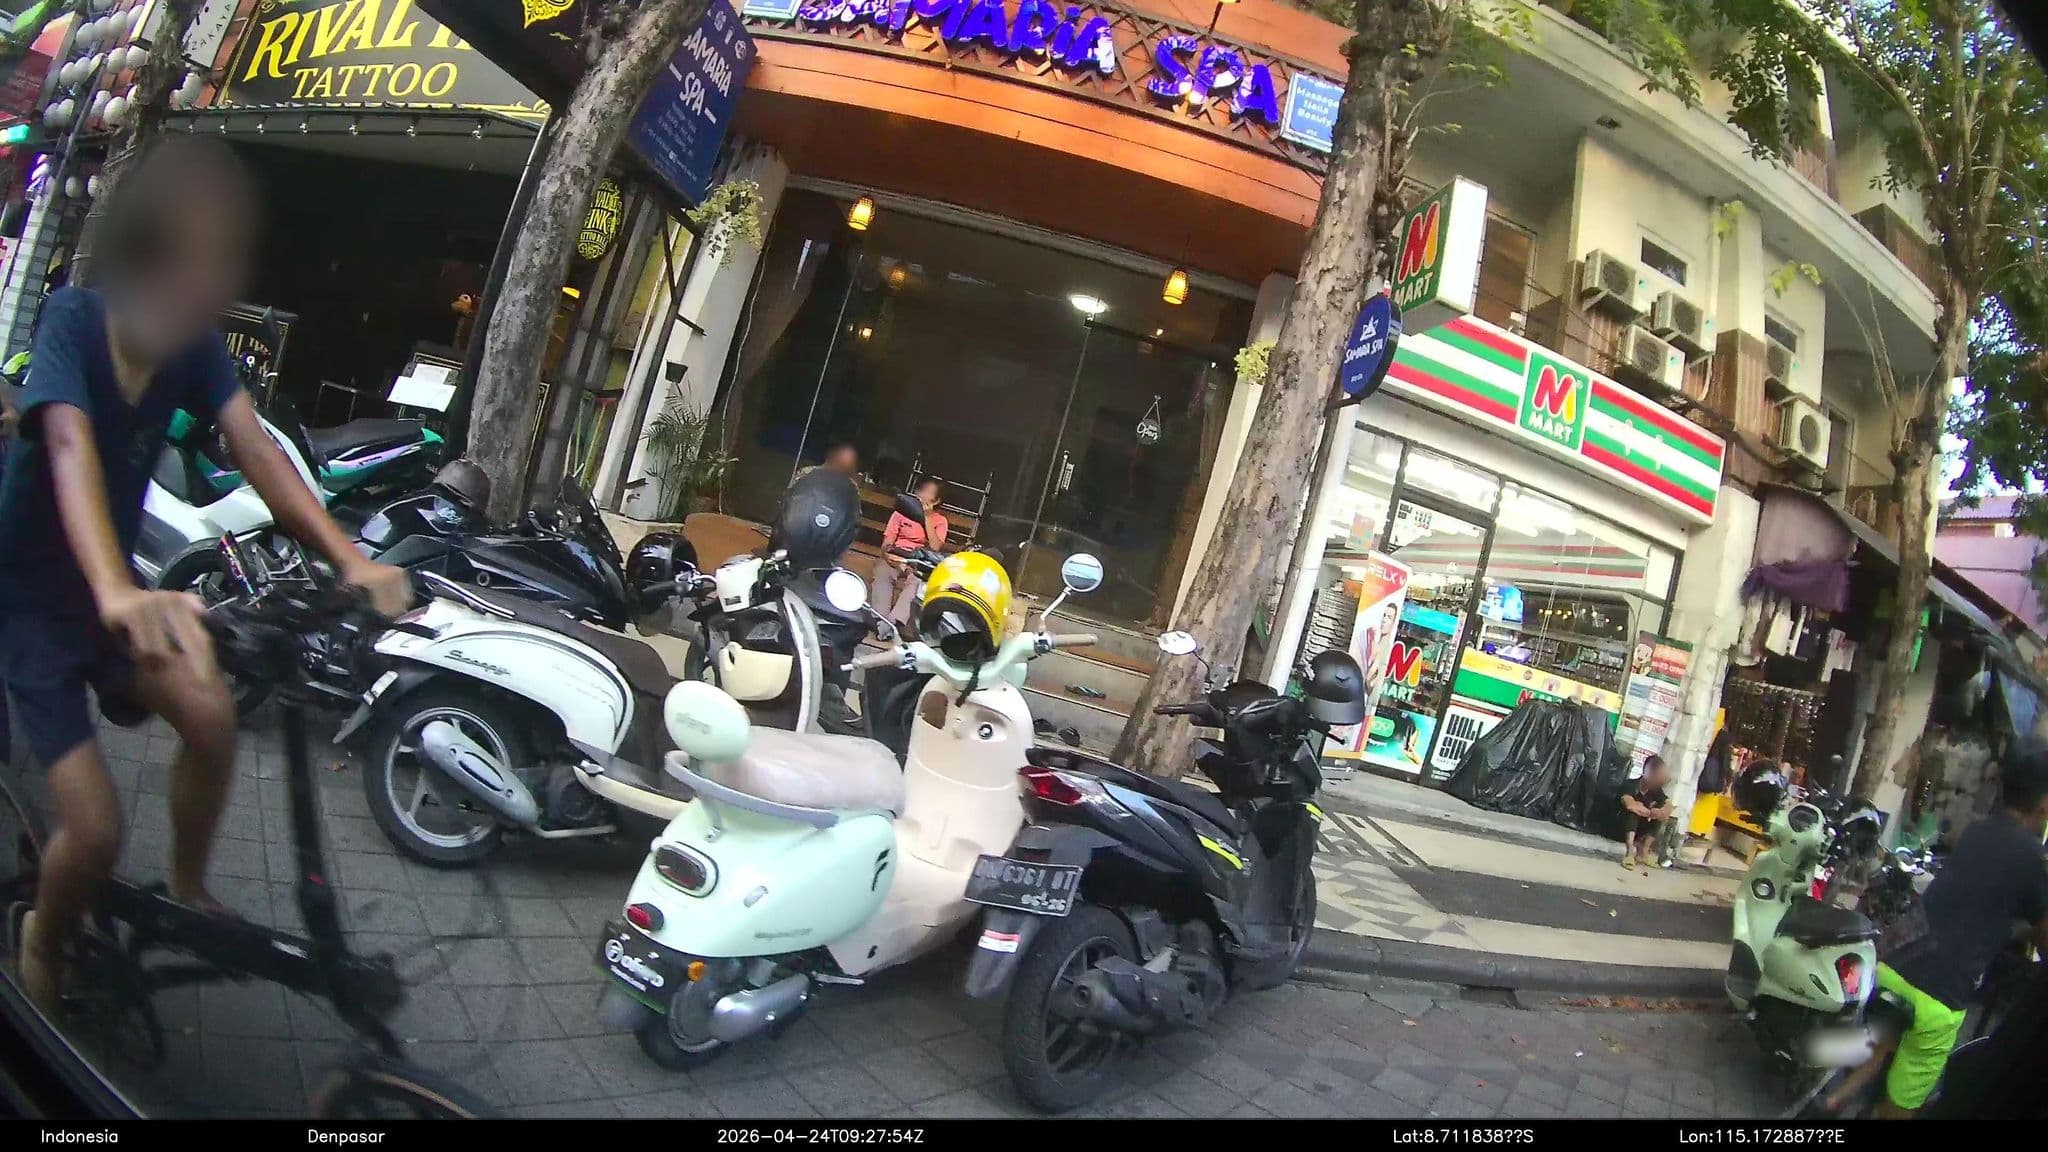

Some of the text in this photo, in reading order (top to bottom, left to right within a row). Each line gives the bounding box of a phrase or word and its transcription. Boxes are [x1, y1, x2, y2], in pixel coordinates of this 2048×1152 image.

[243, 0, 420, 82] RIVAL
[292, 62, 458, 99] TATTOO
[679, 71, 706, 115] SPA
[1148, 35, 1279, 124] SPA
[1394, 272, 1433, 307] MART
[1528, 411, 1573, 443] MART
